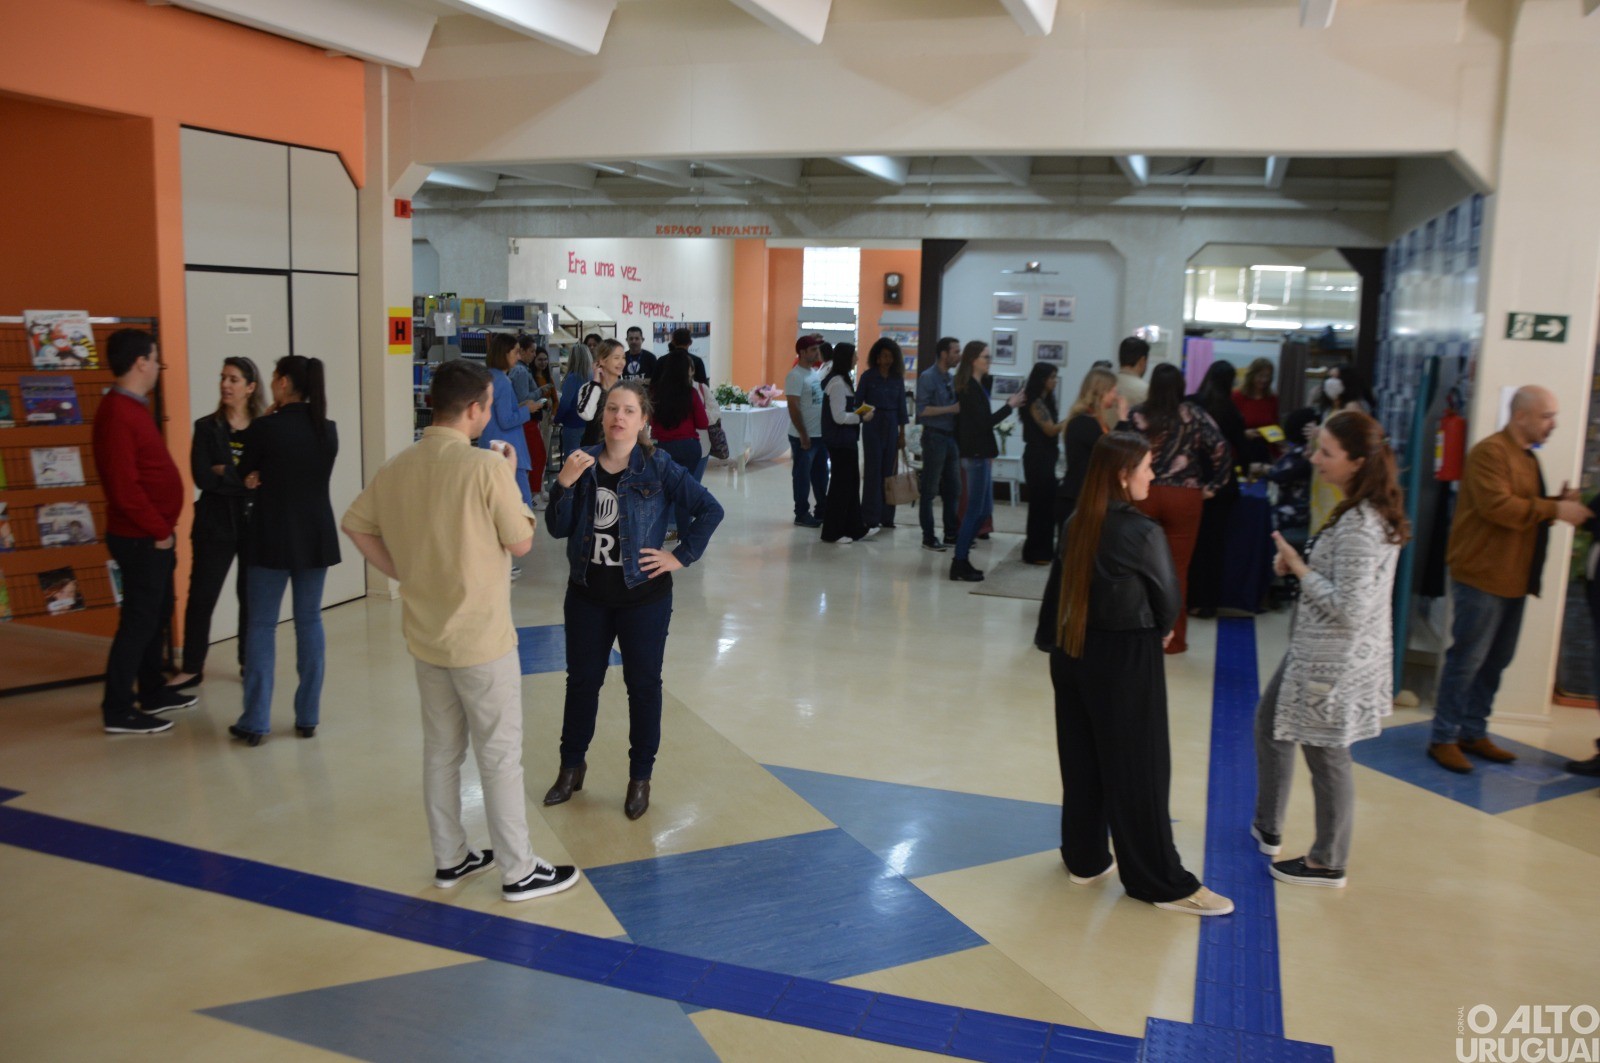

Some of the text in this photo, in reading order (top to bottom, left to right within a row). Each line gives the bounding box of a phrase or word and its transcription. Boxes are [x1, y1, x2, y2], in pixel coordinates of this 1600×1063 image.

[655, 225, 772, 237] ESPAÇO INFANTIL
[568, 251, 587, 275] Era
[594, 261, 615, 277] uma
[622, 294, 633, 315] De
[395, 321, 406, 341] H
